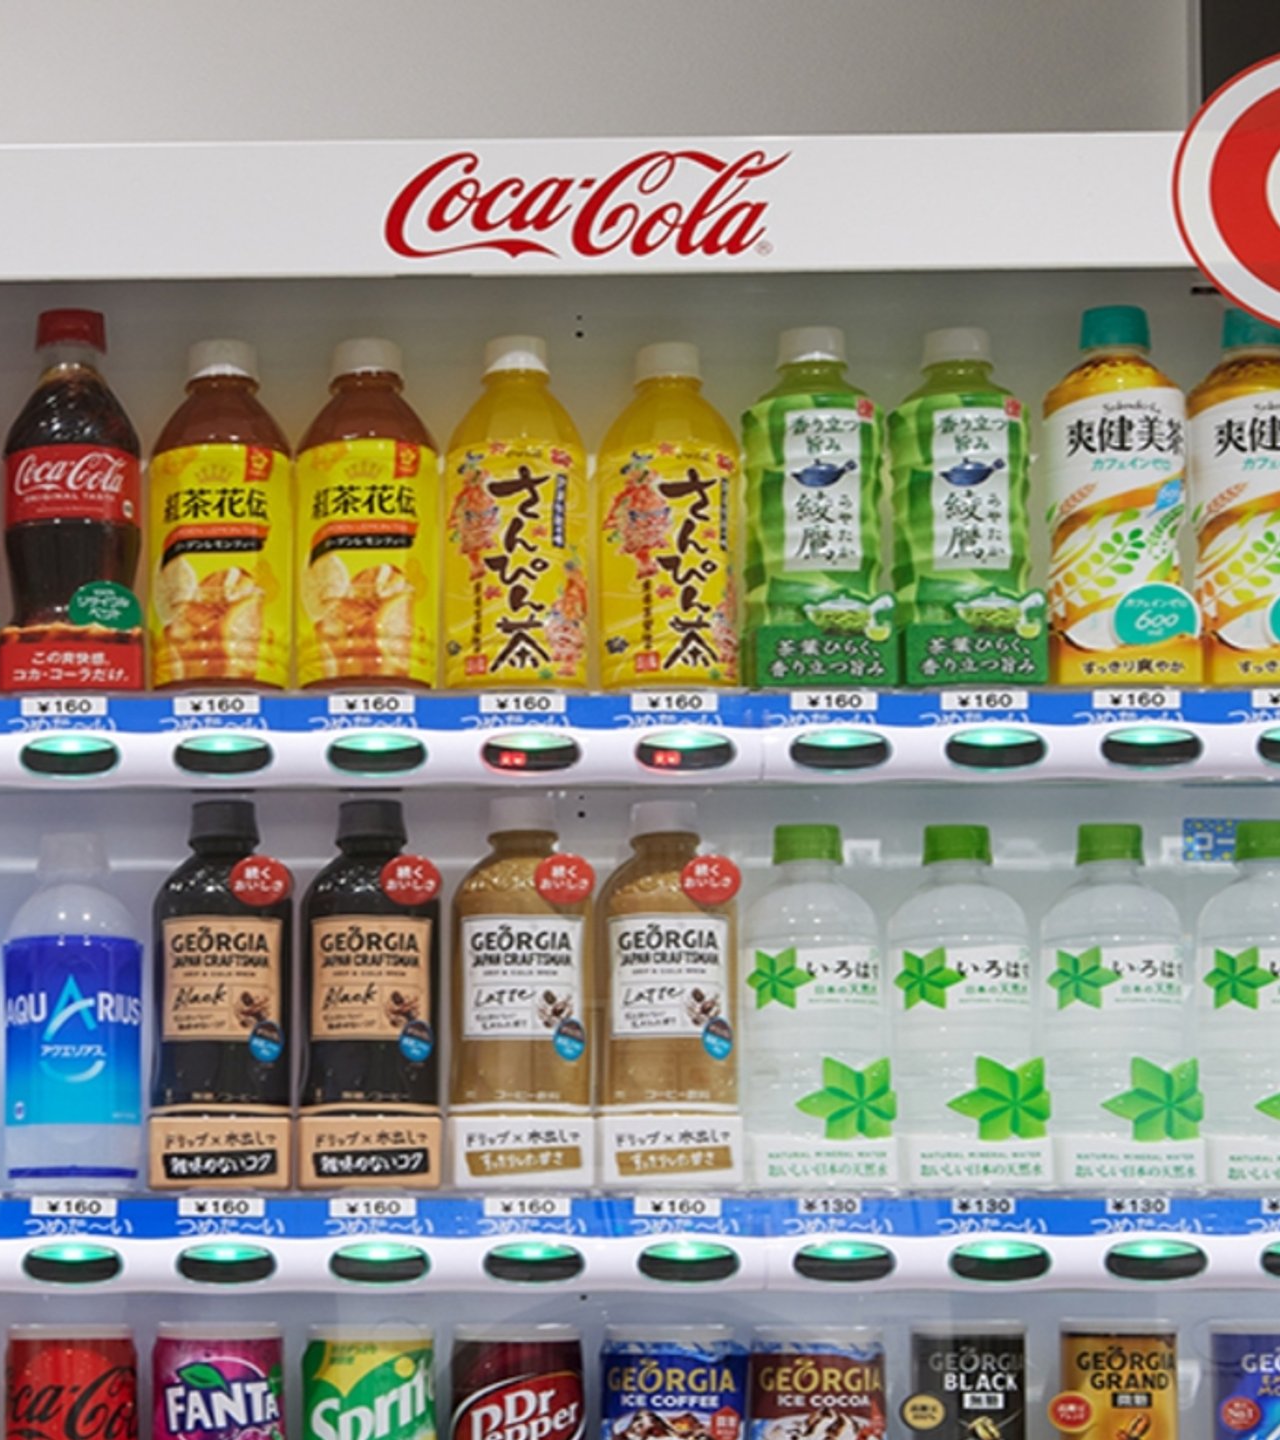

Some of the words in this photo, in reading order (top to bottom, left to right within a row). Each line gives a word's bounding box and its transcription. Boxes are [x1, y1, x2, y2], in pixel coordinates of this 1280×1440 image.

[384, 150, 792, 260] Coca-Cola
[790, 415, 859, 434] 香り立つ
[937, 414, 1009, 434] 香り立つ
[806, 435, 843, 452] 旨み
[954, 434, 991, 452] 旨み
[14, 452, 125, 495] Coca-Cola
[164, 487, 269, 523] 紅茶花伝
[313, 485, 418, 520] 紅茶花伝
[794, 490, 838, 564] 綾鷹
[943, 490, 987, 564] 綾鷹
[484, 465, 551, 672] さんぴん茶
[656, 467, 719, 669] さんぴん茶
[1135, 613, 1180, 630] 600
[769, 658, 885, 678] 香り立つ旨み
[919, 657, 1036, 677] 香り立つ旨み
[1082, 659, 1186, 675] すっきり爽やか
[37, 699, 92, 713] ¥160
[189, 698, 245, 712] ¥160
[344, 697, 400, 710] ¥160
[496, 696, 551, 710] ¥160
[647, 696, 702, 709] ¥160
[807, 694, 862, 708] ¥160
[957, 694, 1013, 707] ¥160
[1109, 693, 1165, 706] ¥160
[234, 879, 284, 893] おいしさ
[386, 879, 436, 892] おいしさ
[539, 878, 590, 891] おいしさ
[684, 877, 733, 890] おいしさ
[171, 925, 269, 952] GEORGIA
[320, 925, 419, 952] GEORGIA
[470, 925, 572, 952] GEORGIA
[619, 924, 718, 951] GEORGIA
[40, 1044, 107, 1059] アクエリアス
[46, 1200, 102, 1214] ¥160
[195, 1200, 250, 1214] ¥160
[345, 1201, 401, 1214] ¥160
[500, 1200, 555, 1214] ¥160
[650, 1200, 706, 1213] ¥160
[804, 1200, 857, 1213] ¥130
[958, 1200, 1011, 1213] ¥130
[1111, 1200, 1165, 1213] ¥130
[608, 1360, 736, 1393] GEORGIA
[759, 1358, 884, 1393] GEORGIA
[943, 1372, 1019, 1392] BLACK
[1090, 1372, 1170, 1390] GRAND
[165, 1381, 280, 1432] FANTA
[504, 1388, 556, 1425] Dr
[621, 1394, 646, 1408] ICE
[650, 1394, 719, 1408] COFFEE
[777, 1394, 805, 1407] ICE
[809, 1394, 871, 1408] COCOA
